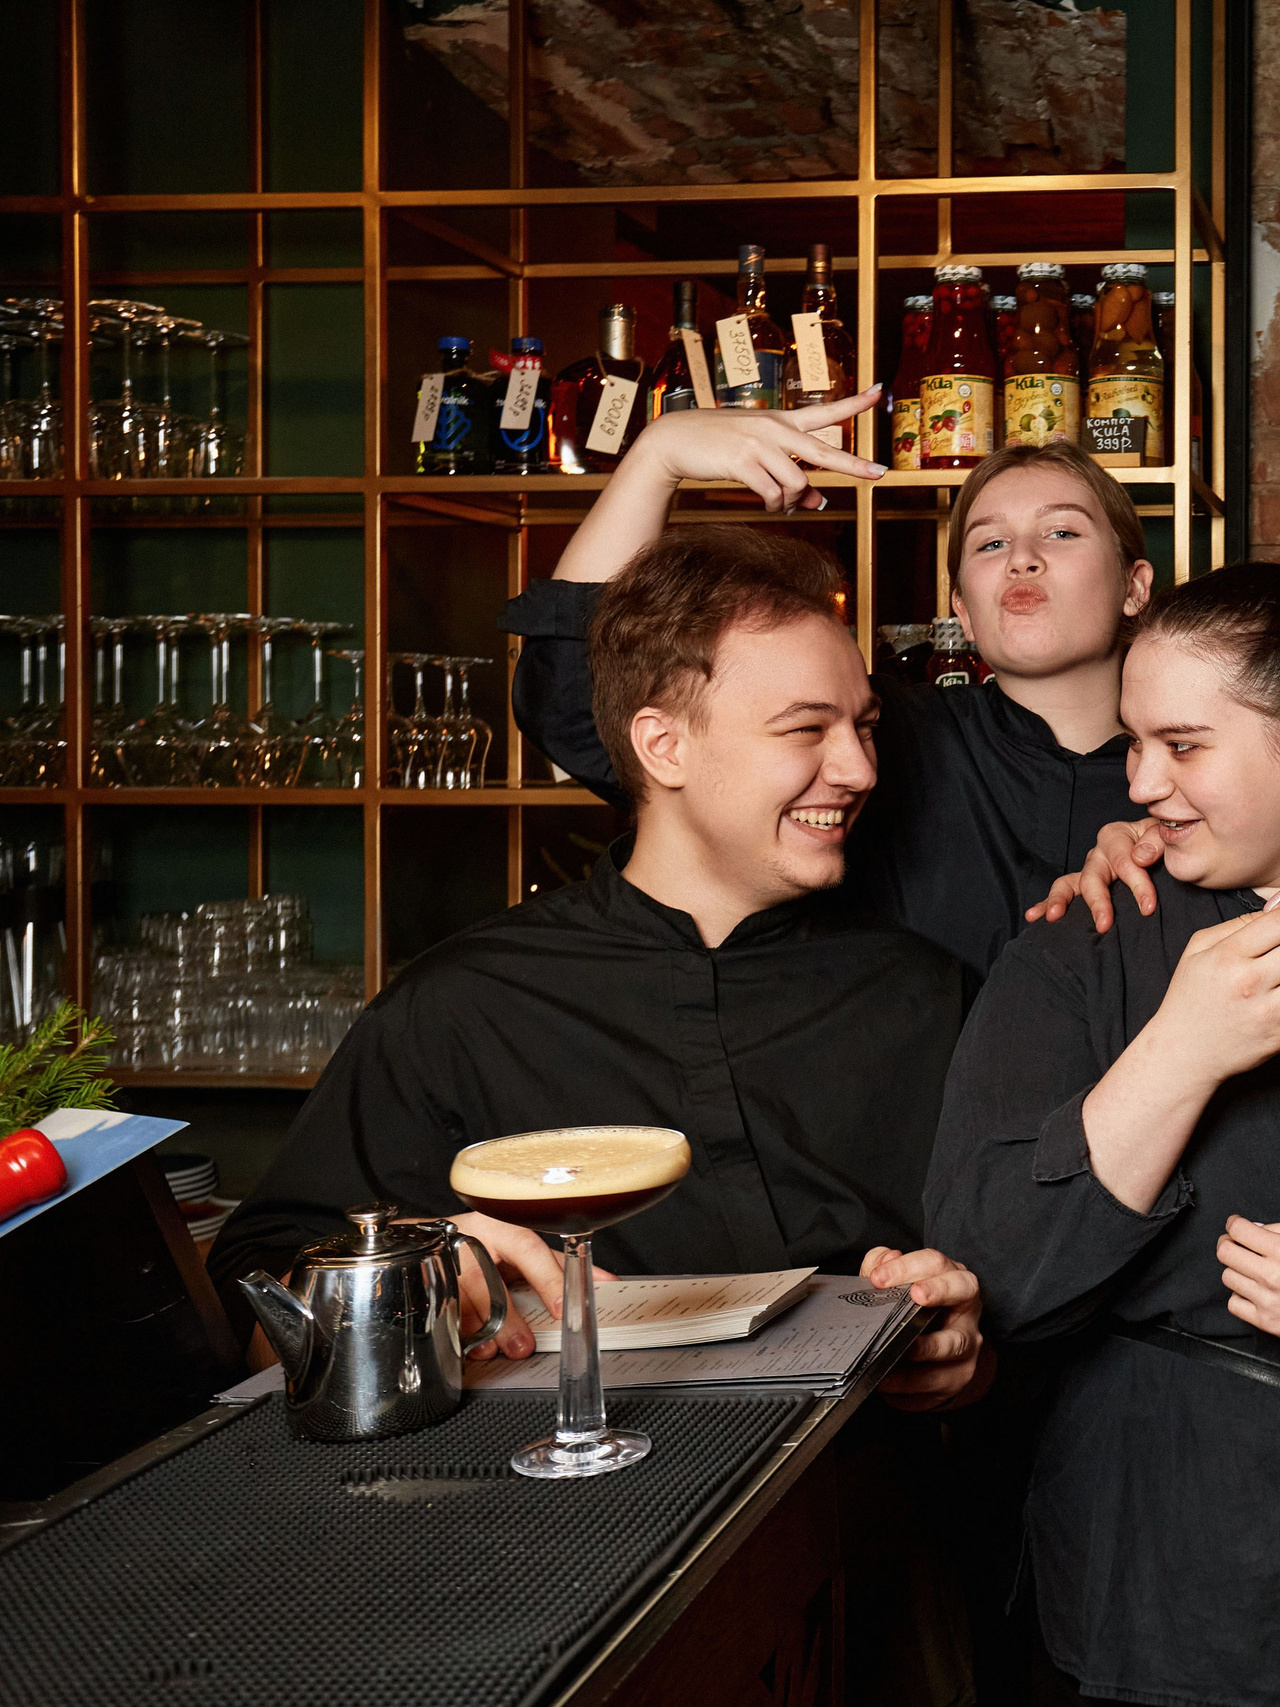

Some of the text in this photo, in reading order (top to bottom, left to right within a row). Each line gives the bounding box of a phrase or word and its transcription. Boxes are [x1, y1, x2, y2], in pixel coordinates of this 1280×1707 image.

[926, 377, 953, 391] Kula
[1014, 376, 1045, 390] Kula
[1086, 417, 1135, 429] КОМПОТ
[1092, 425, 1130, 438] KULA
